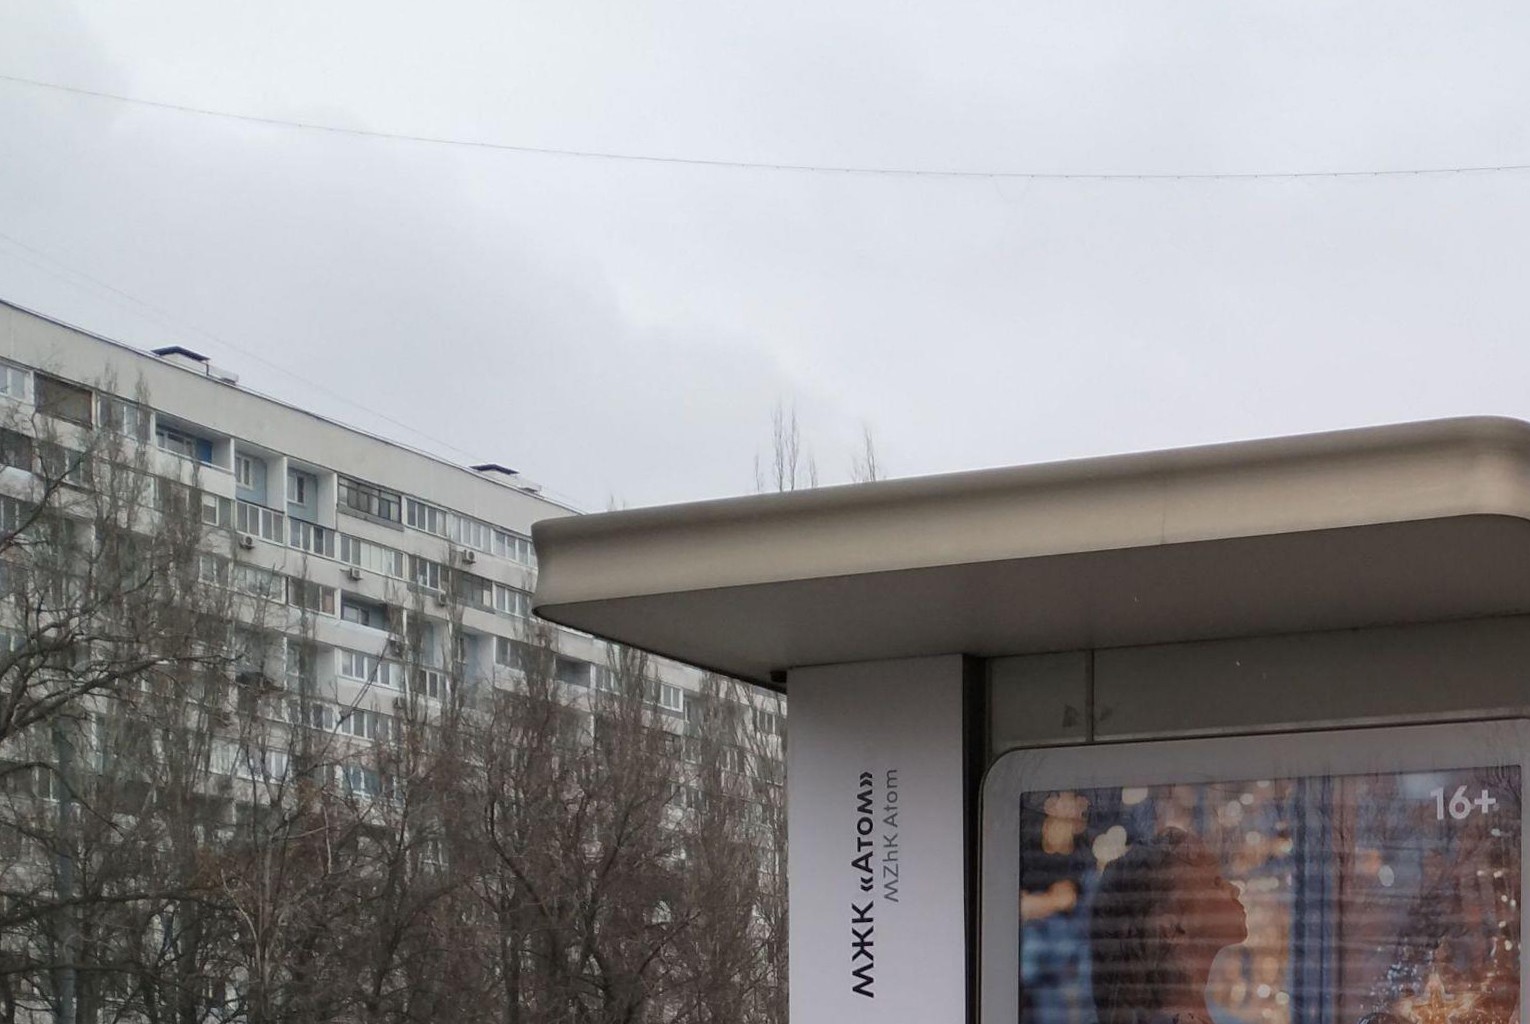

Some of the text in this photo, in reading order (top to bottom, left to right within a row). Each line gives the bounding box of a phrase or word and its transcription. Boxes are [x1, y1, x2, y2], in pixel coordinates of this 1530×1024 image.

[882, 768, 899, 903] MZhK Atom
[1430, 785, 1496, 820] 16+
[851, 900, 874, 998] МЖК
